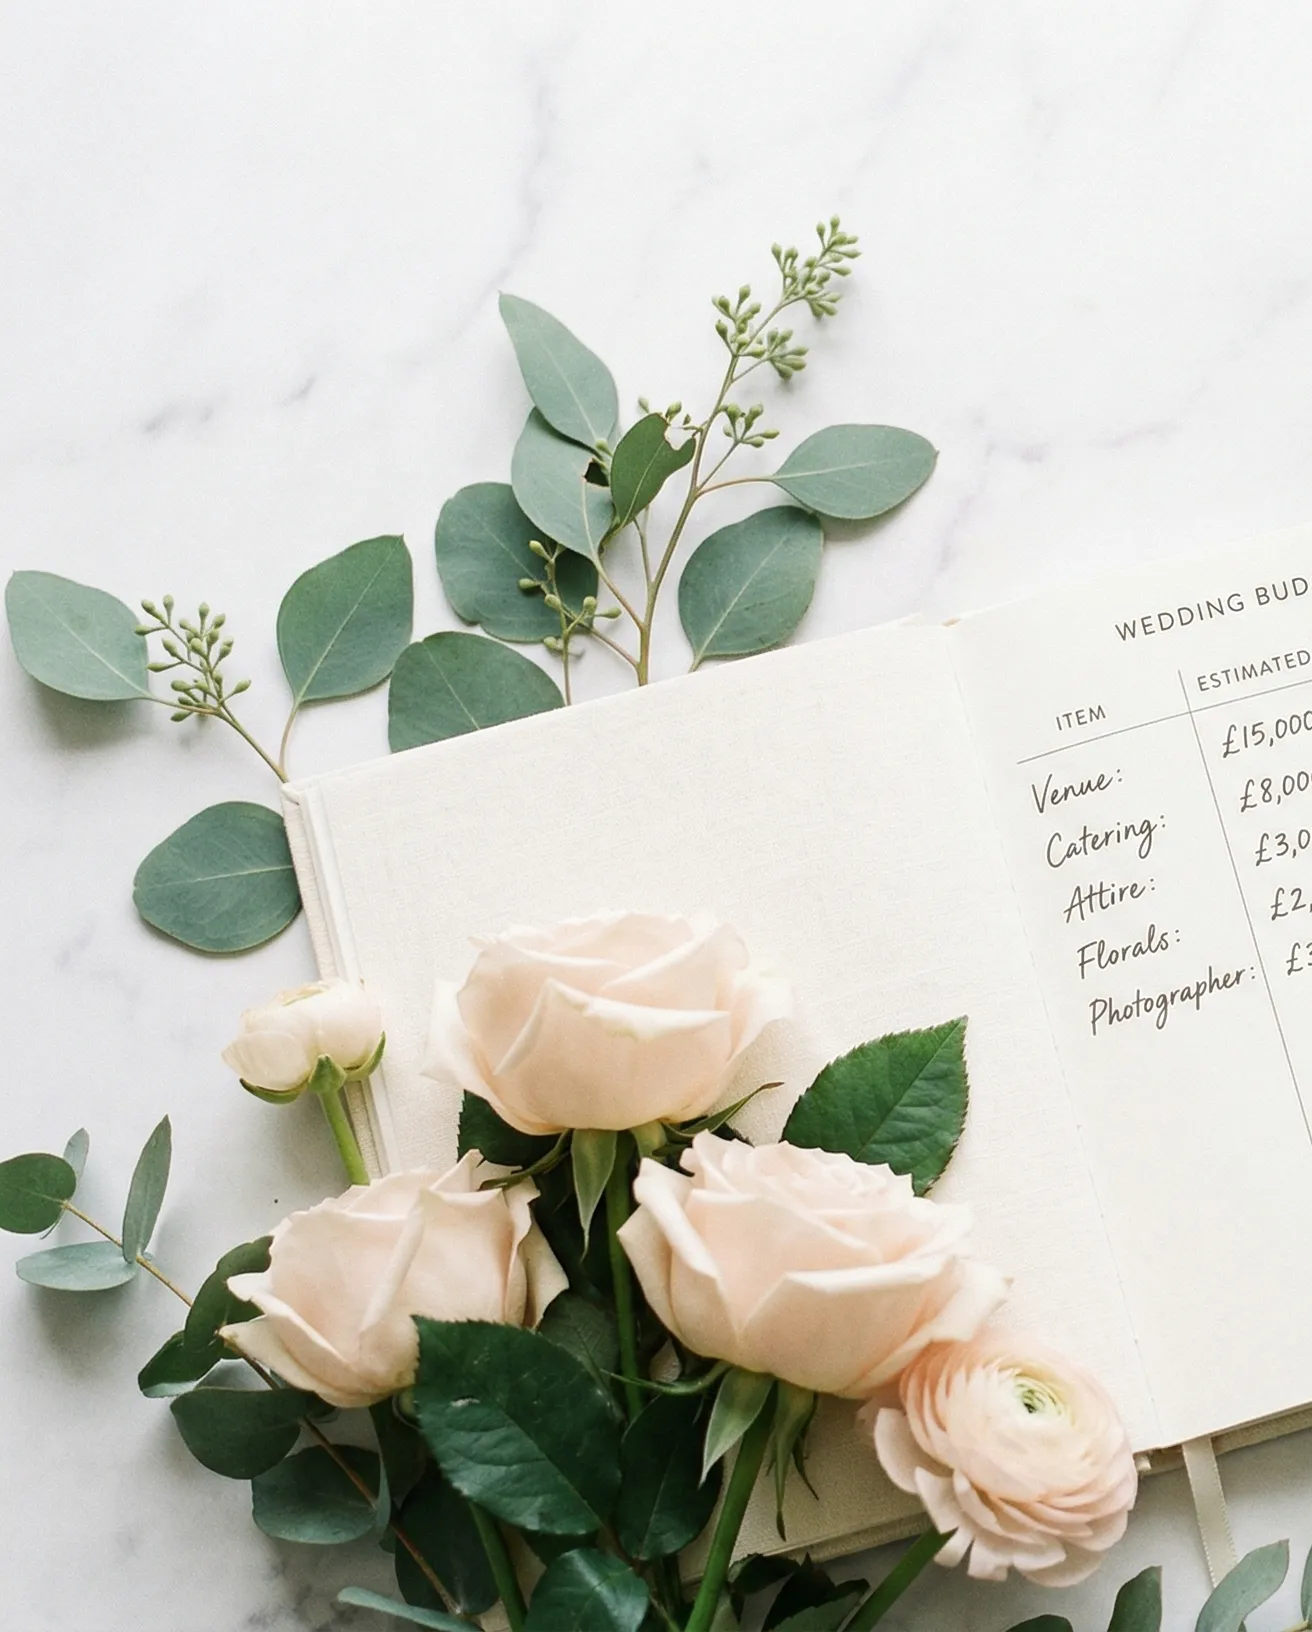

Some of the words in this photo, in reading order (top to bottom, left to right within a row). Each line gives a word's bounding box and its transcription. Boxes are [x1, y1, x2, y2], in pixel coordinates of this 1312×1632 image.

[1115, 593, 1244, 641] WEDDING
[1056, 705, 1106, 730] ITEM
[1197, 650, 1310, 691] ESTIMATED
[1032, 769, 1122, 813] Venue:
[1047, 815, 1165, 868] Catering:
[1063, 879, 1155, 923] Attire:
[1077, 924, 1180, 979] Florals:
[1089, 966, 1255, 1036] Photographer:
